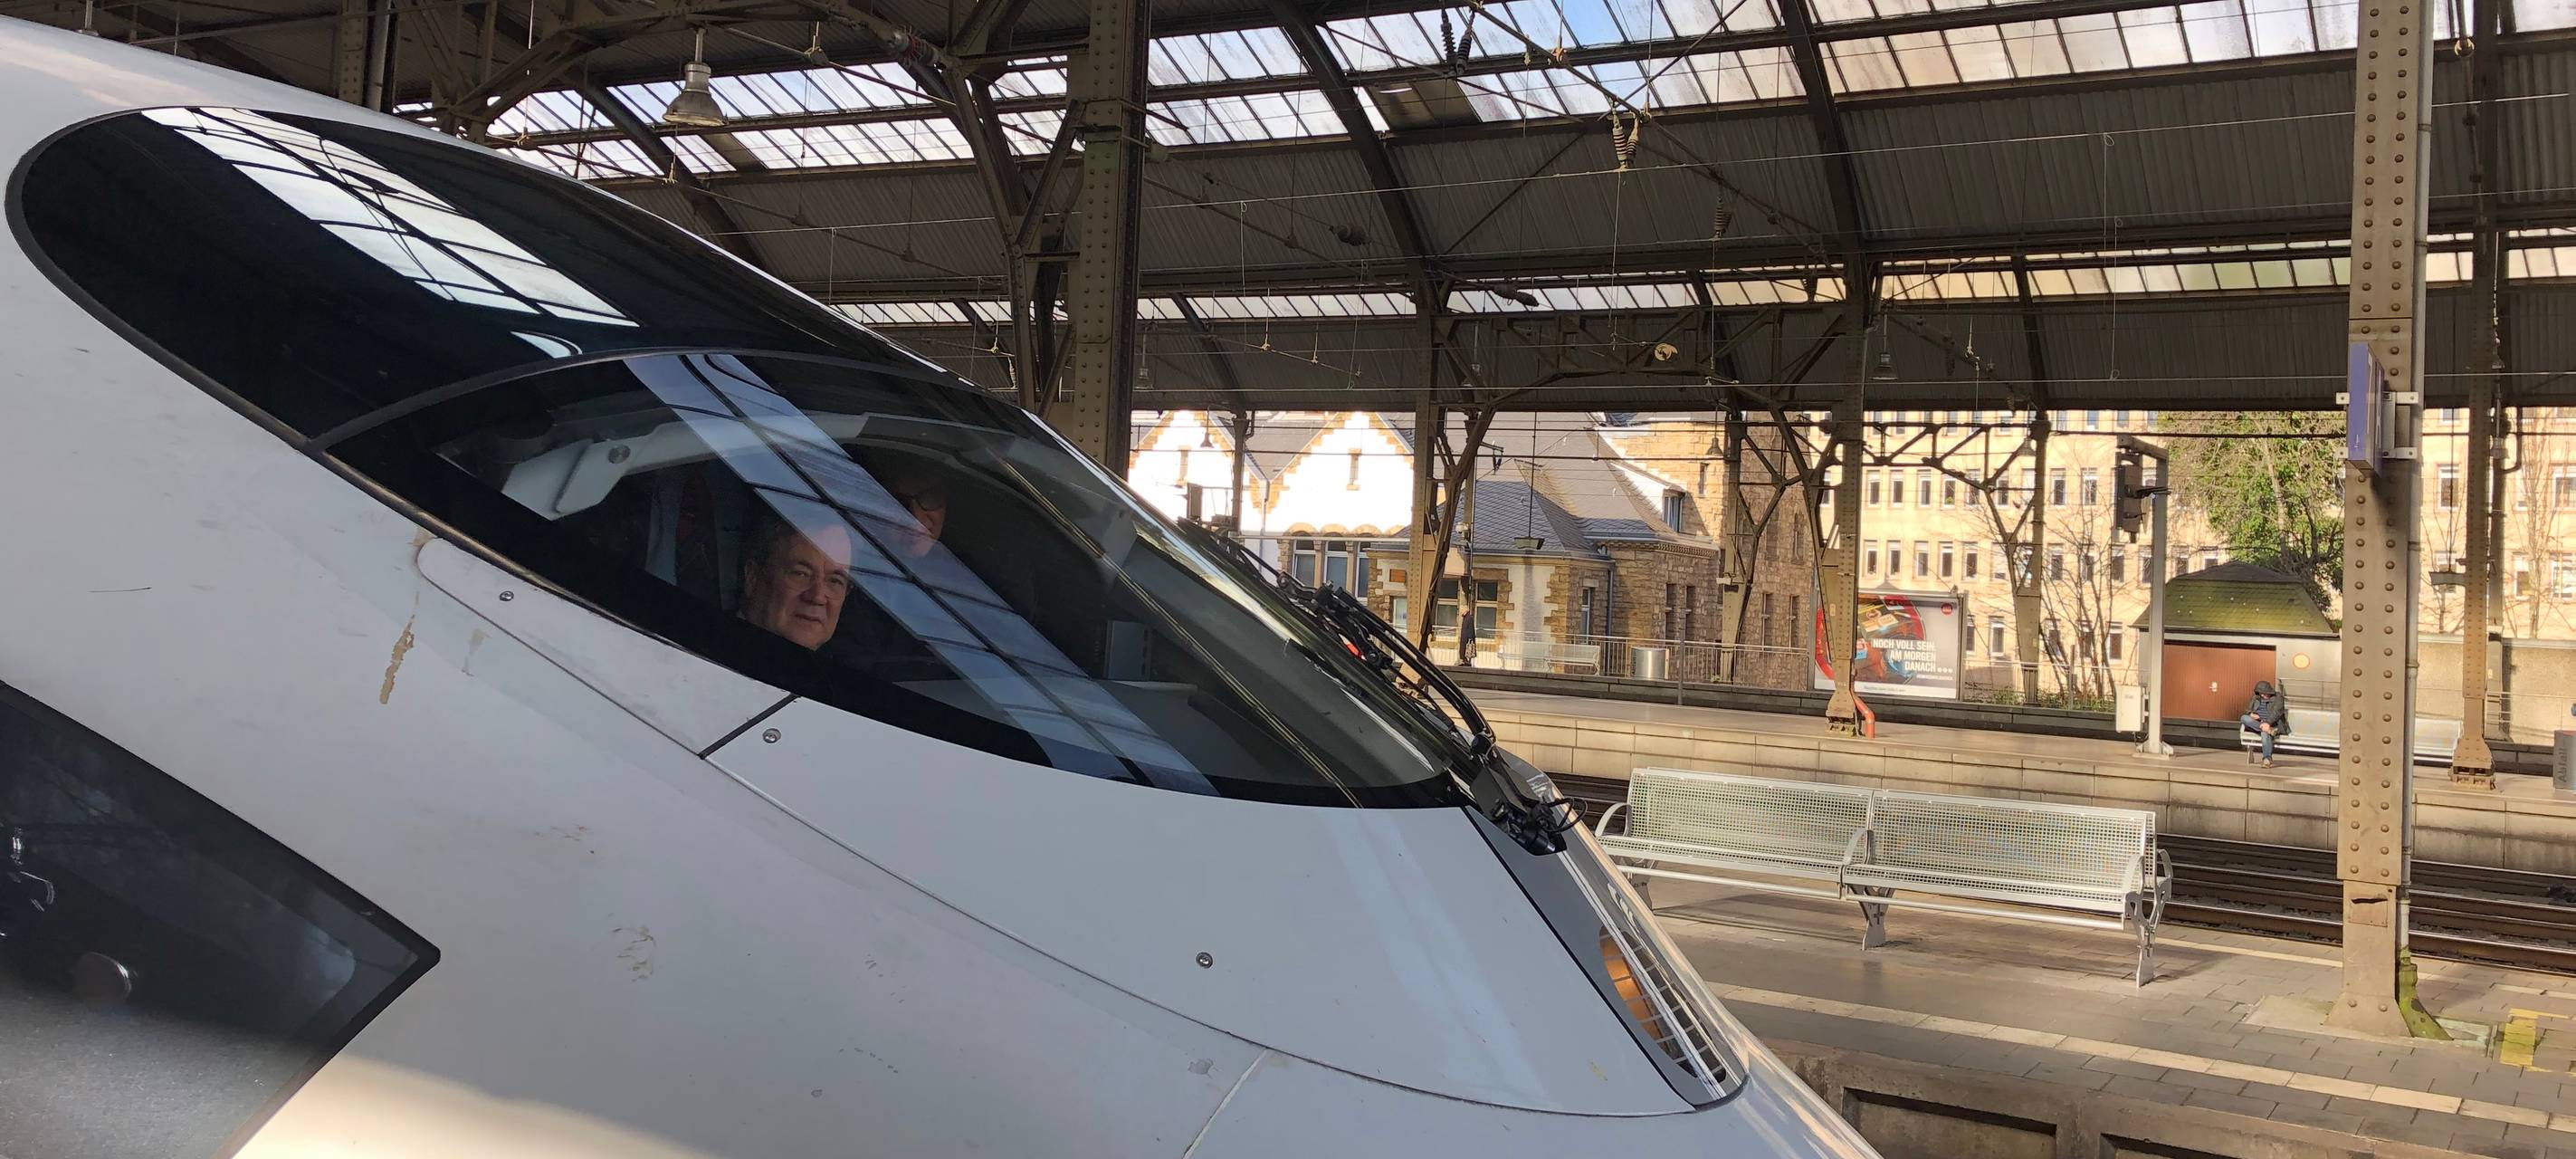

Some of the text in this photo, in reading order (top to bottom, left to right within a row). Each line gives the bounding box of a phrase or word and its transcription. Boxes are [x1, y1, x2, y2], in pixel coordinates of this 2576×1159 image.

[1873, 638, 1894, 648] NOCH
[1895, 639, 1915, 650] VOLL
[1890, 650, 1936, 662] AM MORGEN
